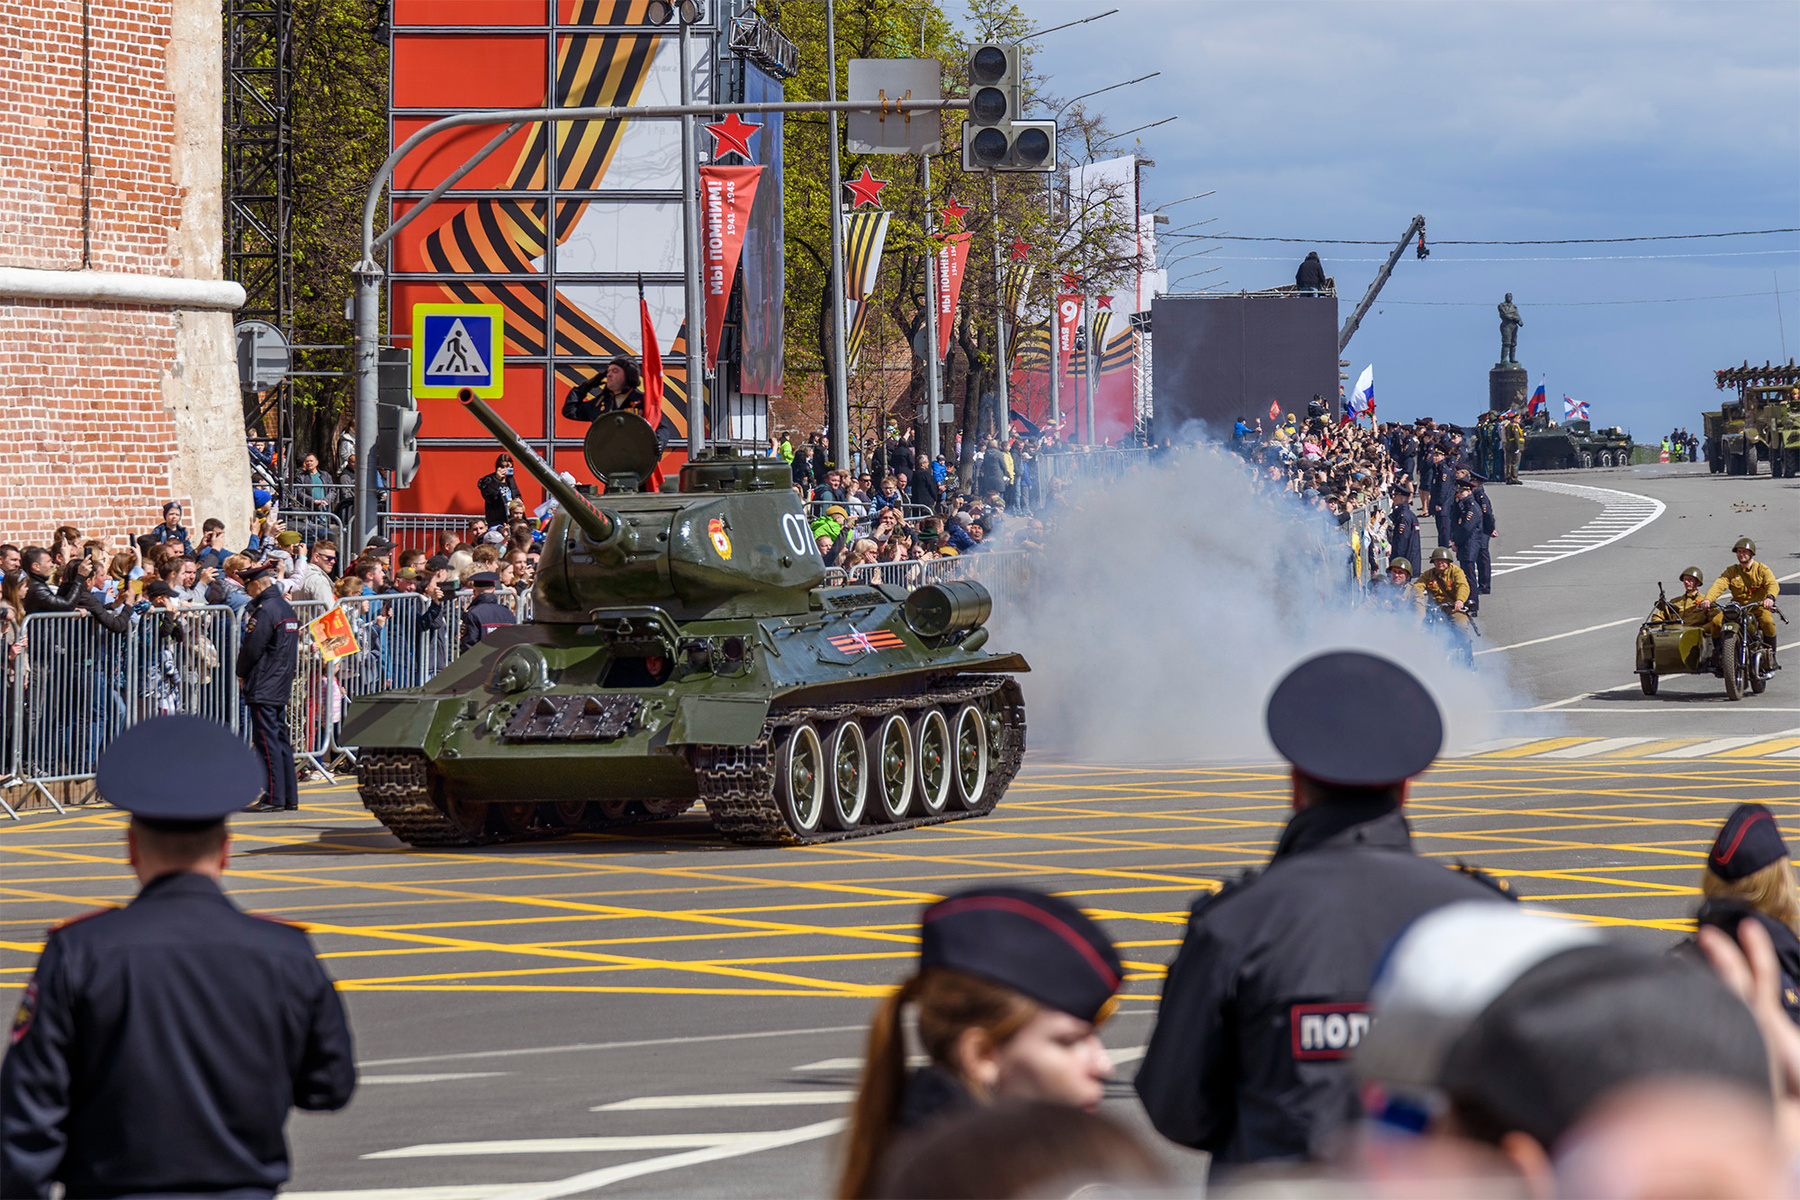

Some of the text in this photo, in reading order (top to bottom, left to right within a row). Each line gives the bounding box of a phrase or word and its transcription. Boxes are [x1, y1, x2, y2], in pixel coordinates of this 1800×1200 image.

[727, 181, 735, 204] 1945
[727, 213, 735, 235] 1941
[708, 181, 723, 295] МЫ ПОМНИМ!
[941, 295, 951, 314] МЫ
[1061, 300, 1078, 323] 9
[1061, 327, 1070, 351] МАЯ
